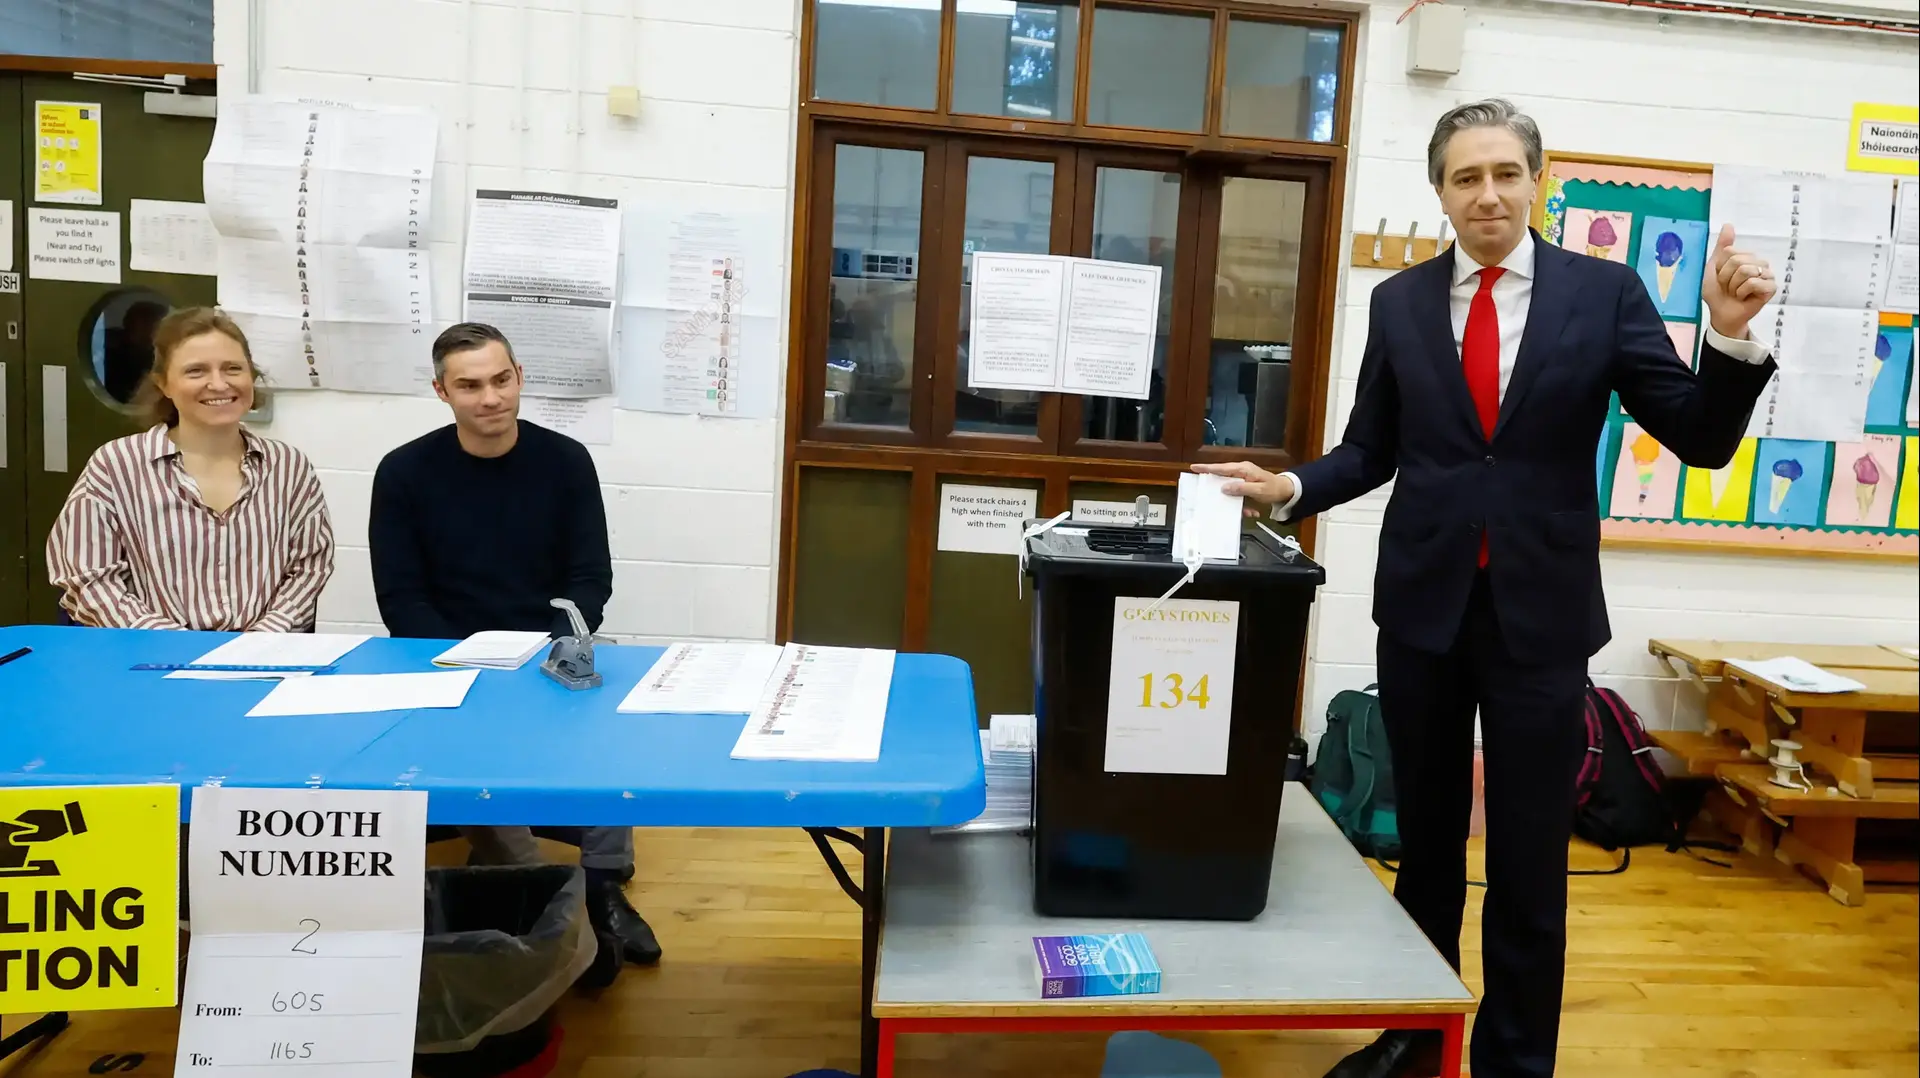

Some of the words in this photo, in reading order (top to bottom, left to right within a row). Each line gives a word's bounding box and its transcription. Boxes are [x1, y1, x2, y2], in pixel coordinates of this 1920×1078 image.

[40, 216, 62, 224] Please
[64, 217, 83, 225] leave
[408, 169, 421, 279] REPLACEMENT
[47, 242, 67, 250] (Neat
[85, 244, 102, 253] Tidy)
[34, 255, 57, 263] Please
[96, 259, 115, 267] lights
[410, 292, 420, 334] LISTS
[950, 495, 974, 503] Please
[997, 498, 1020, 506] chairs
[951, 507, 968, 516] high
[992, 509, 1023, 518] finished
[1093, 508, 1117, 517] sitting
[1130, 510, 1159, 518] sted
[1123, 608, 1231, 623] GREYSTONES
[1138, 672, 1210, 710] 134
[236, 810, 382, 838] BOOTH
[218, 850, 395, 877] NUMBER
[292, 918, 321, 954] 2
[1062, 945, 1078, 966] GOOD
[1074, 944, 1091, 965] NEWS
[1086, 944, 1105, 965] BIBLE
[195, 1003, 243, 1017] From:
[272, 991, 324, 1012] 605
[190, 1053, 213, 1067] To:
[270, 1042, 313, 1060] 1165
